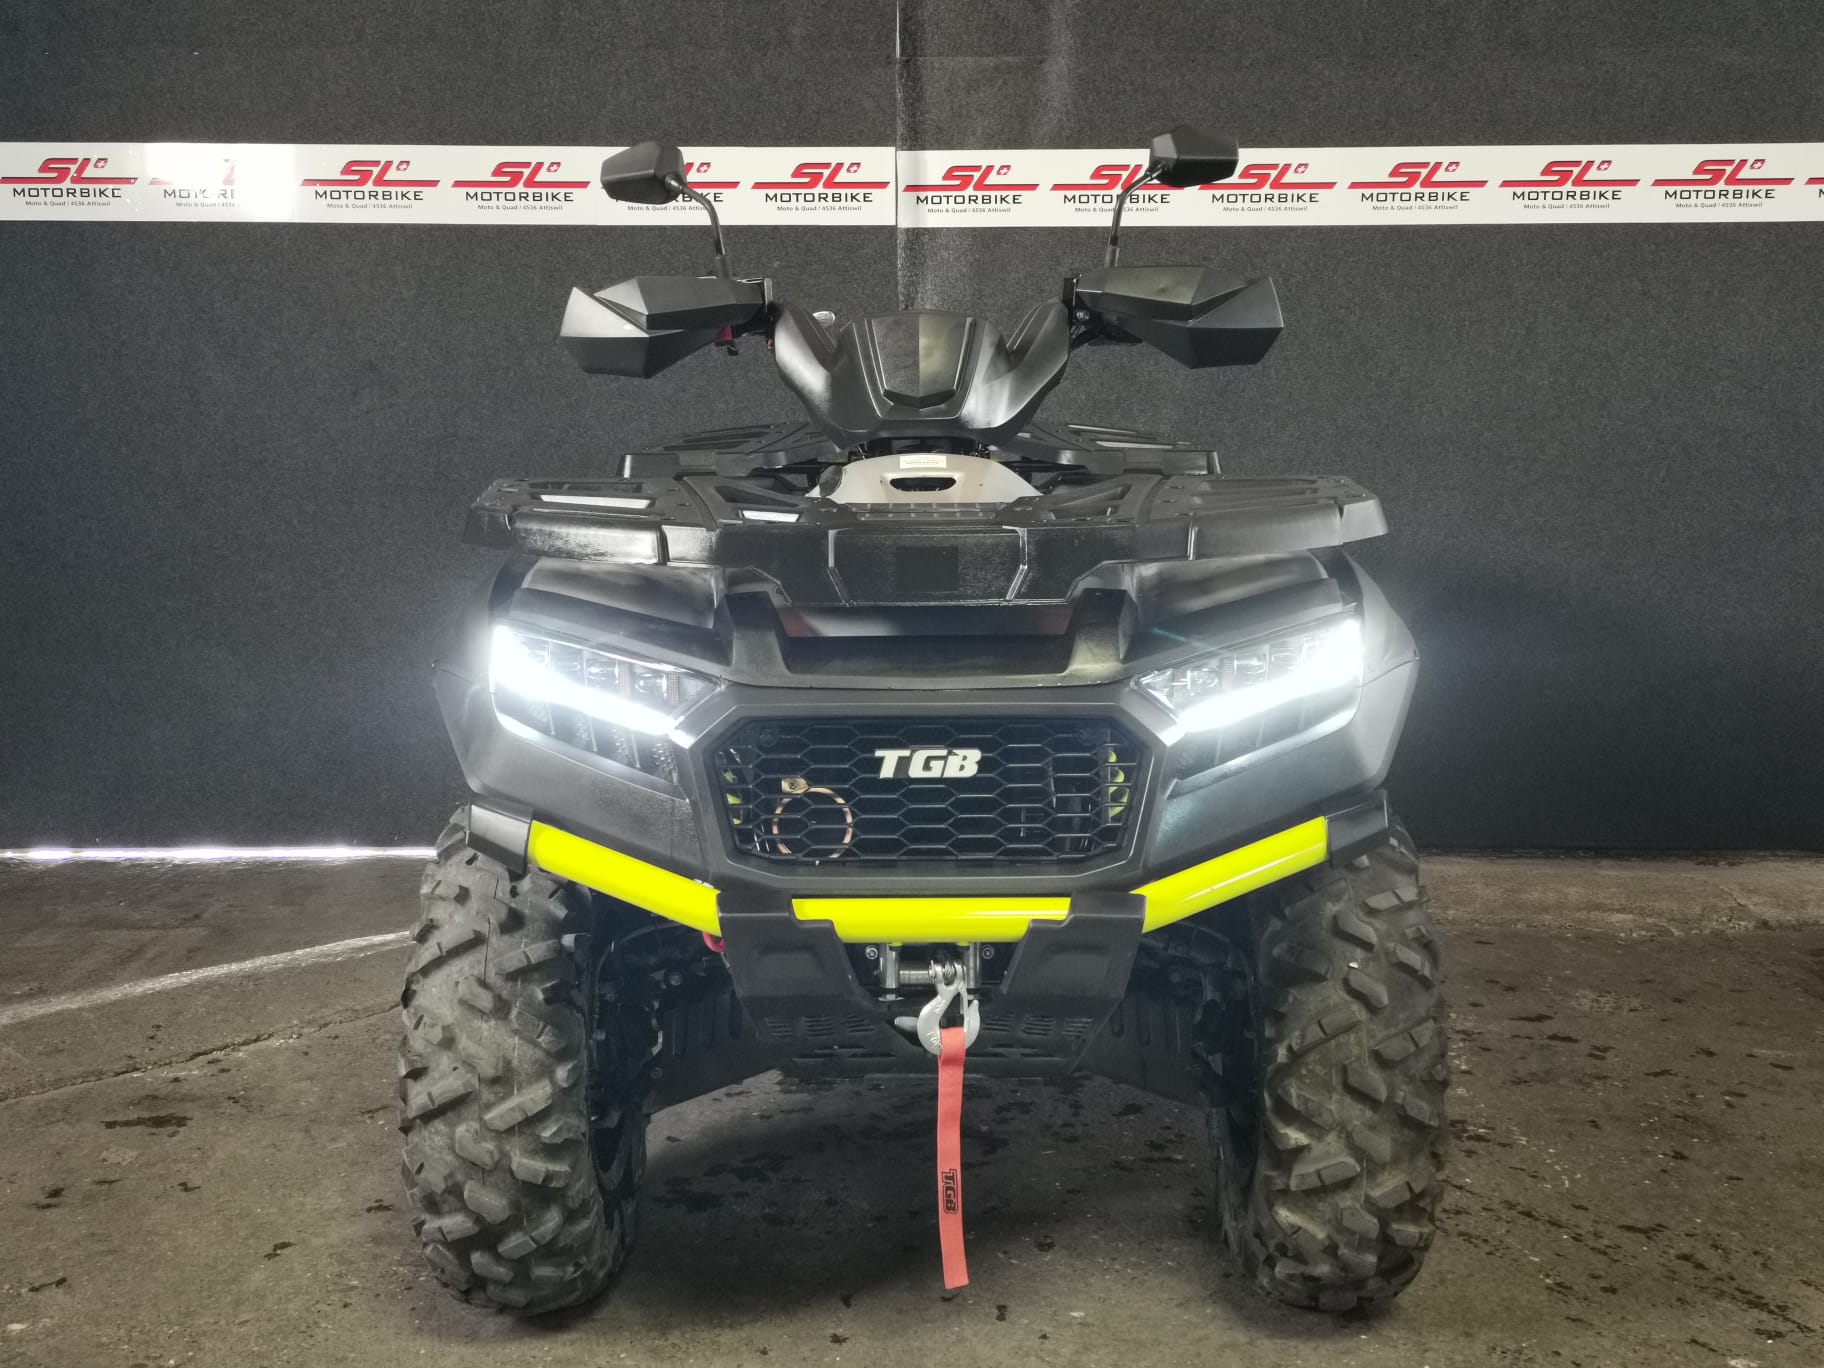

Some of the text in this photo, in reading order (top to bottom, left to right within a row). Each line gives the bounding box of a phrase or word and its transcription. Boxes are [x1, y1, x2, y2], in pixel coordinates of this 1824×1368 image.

[13, 188, 122, 198] MOTORBIKE
[315, 190, 424, 200] MOTORBIKE
[466, 192, 574, 202] MOTORBIKE
[765, 192, 873, 202] MOTORBIKE
[1212, 193, 1320, 203] MOTORBIKE
[1362, 192, 1470, 202] MOTORBIKE
[1512, 190, 1622, 200] MOTORBIKE
[1664, 189, 1776, 199] MOTORBIKE
[916, 194, 1022, 205] MOTORBIKE
[1064, 194, 1170, 204] MOTOBIKE
[874, 748, 982, 779] TGB
[942, 1169, 958, 1213] TGB
